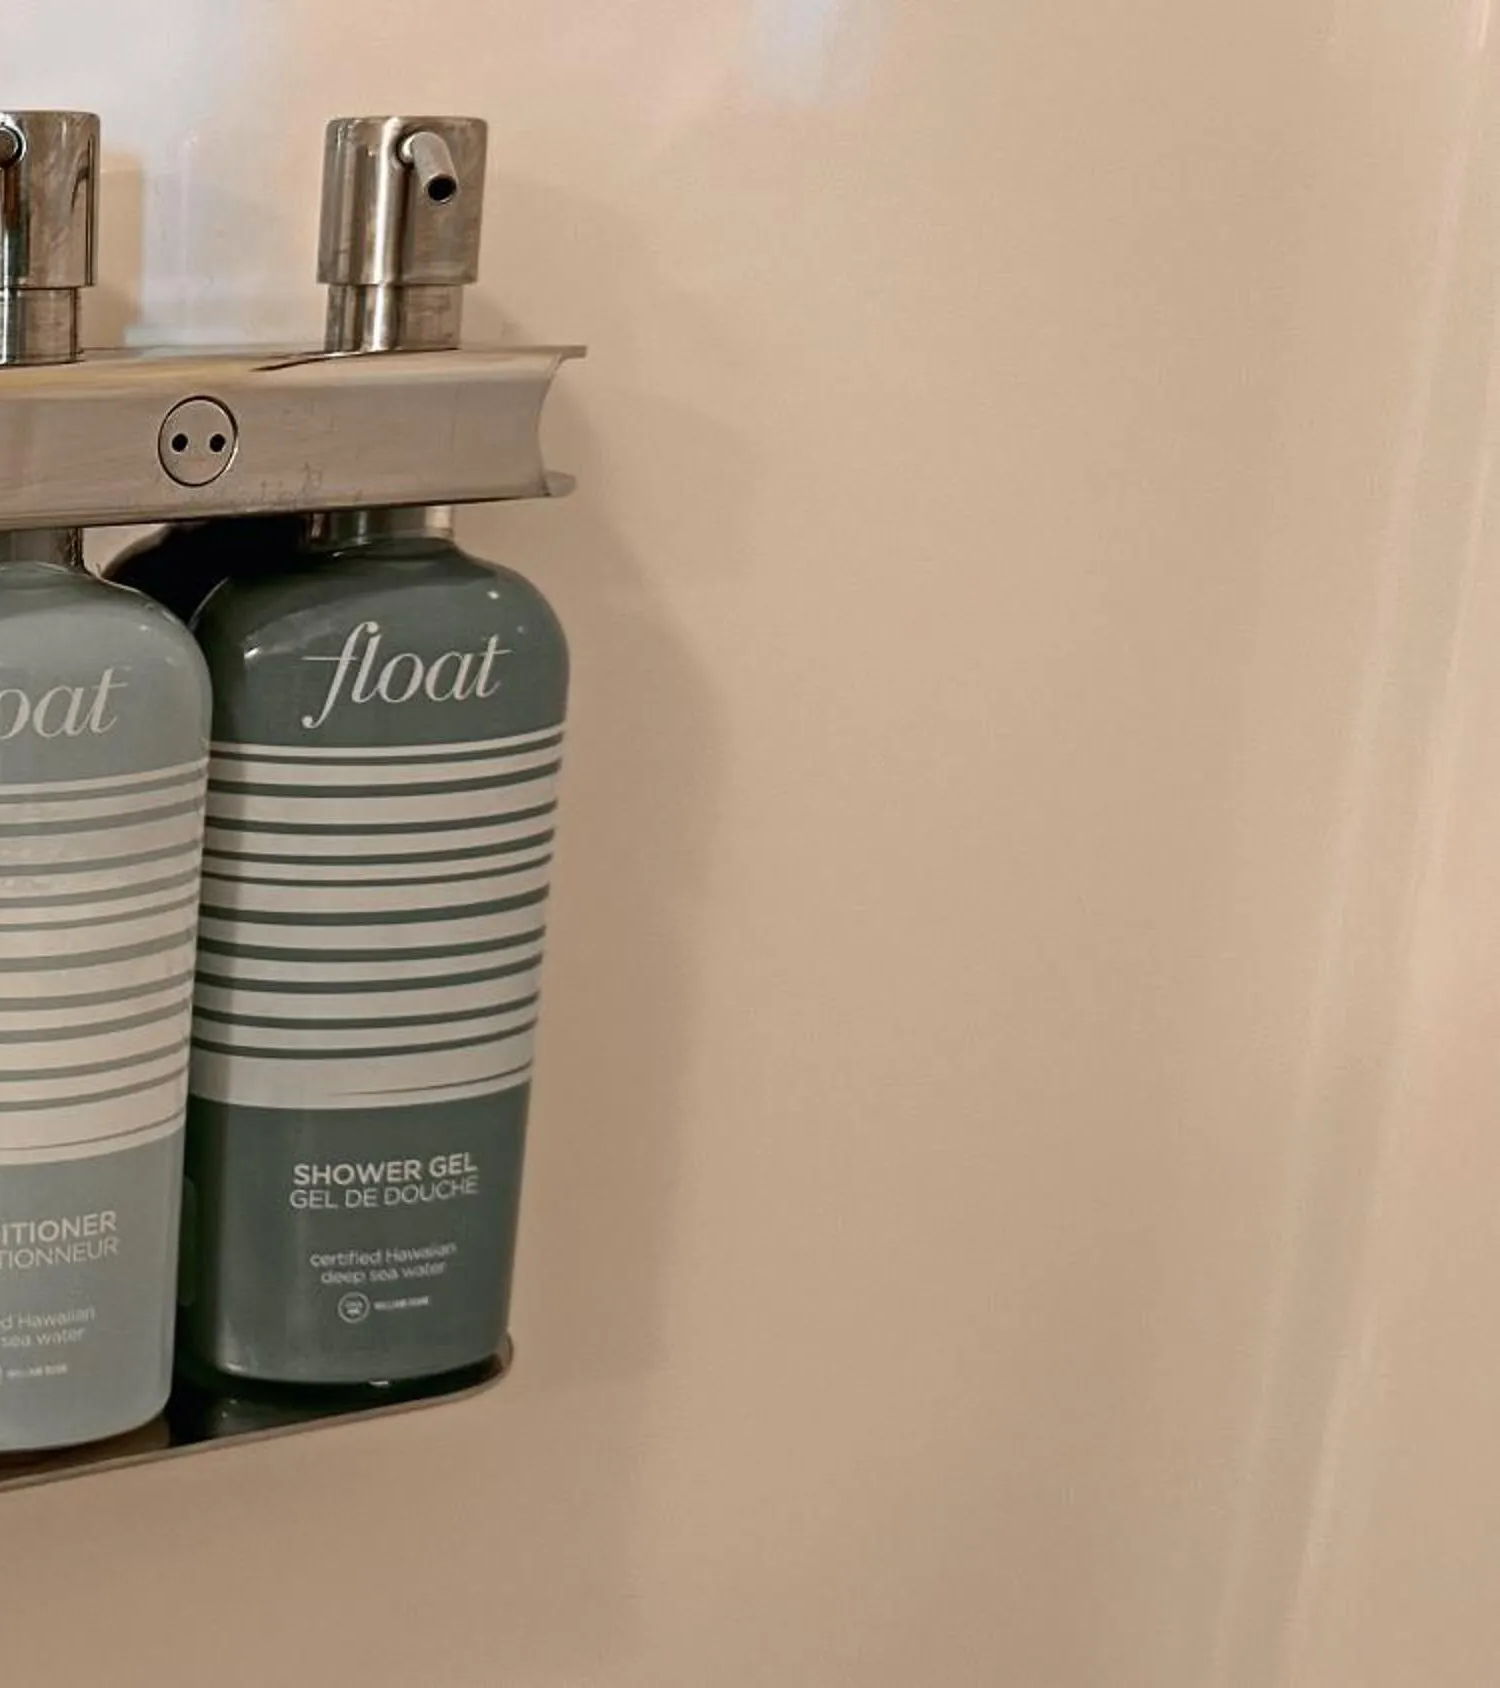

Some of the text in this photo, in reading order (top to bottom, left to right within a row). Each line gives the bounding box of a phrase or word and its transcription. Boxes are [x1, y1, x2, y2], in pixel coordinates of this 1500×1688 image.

[302, 621, 512, 728] float
[293, 1152, 478, 1185] SHOWER GEL
[290, 1175, 479, 1209] GEL DE DOUCHE
[310, 1250, 382, 1267] certified
[321, 1261, 446, 1285] deep sea water
[18, 1305, 96, 1329] Hawaiian
[1, 1335, 31, 1347] sea
[36, 1327, 85, 1344] water
